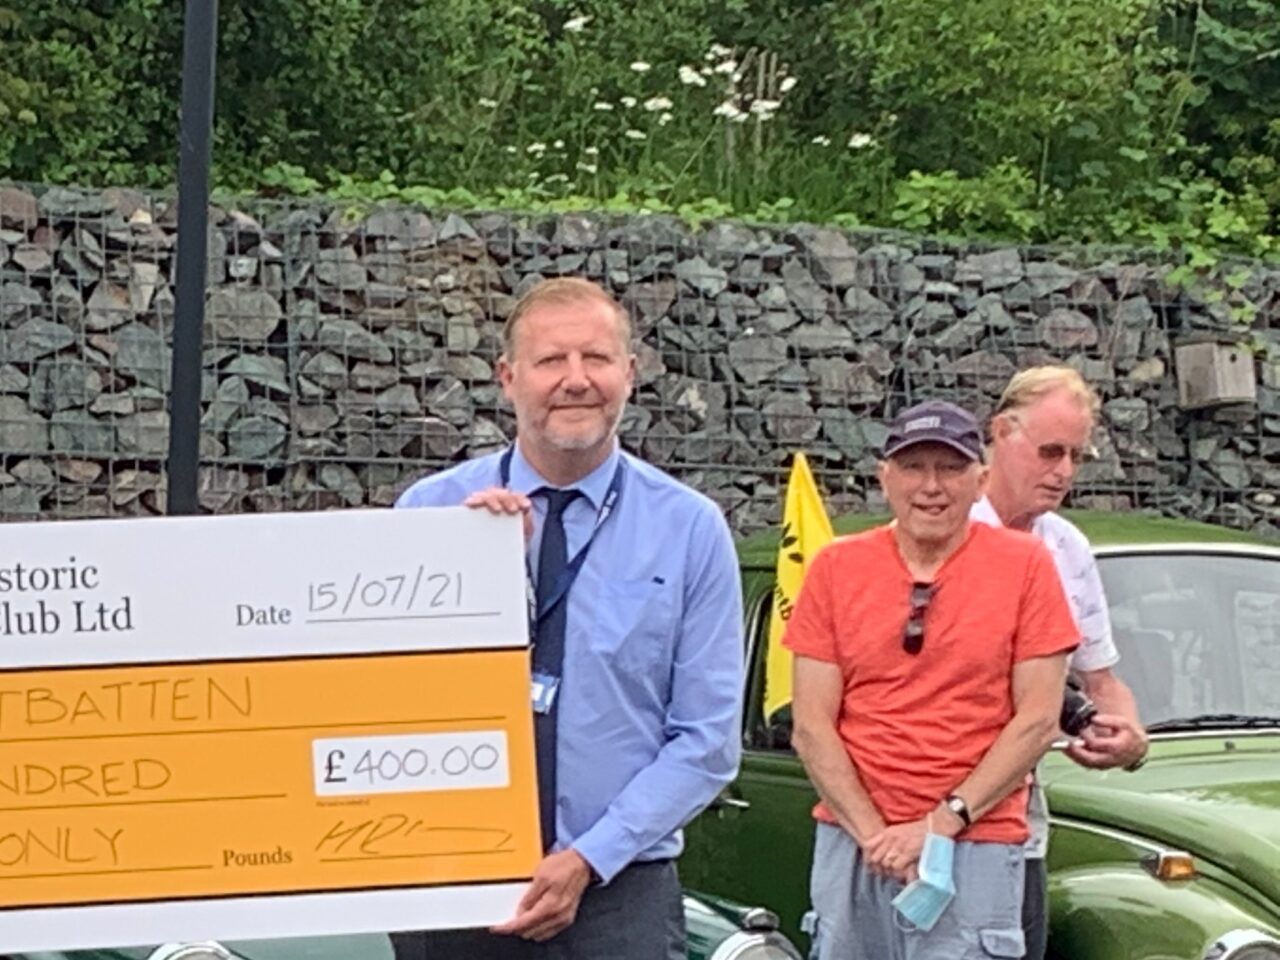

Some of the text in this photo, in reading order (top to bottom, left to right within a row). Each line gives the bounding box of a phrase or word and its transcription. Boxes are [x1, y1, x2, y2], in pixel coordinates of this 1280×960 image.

[308, 565, 462, 615] 15/07/21
[73, 597, 135, 632] Ltd
[236, 604, 292, 627] Date
[222, 846, 293, 868] Pounds
